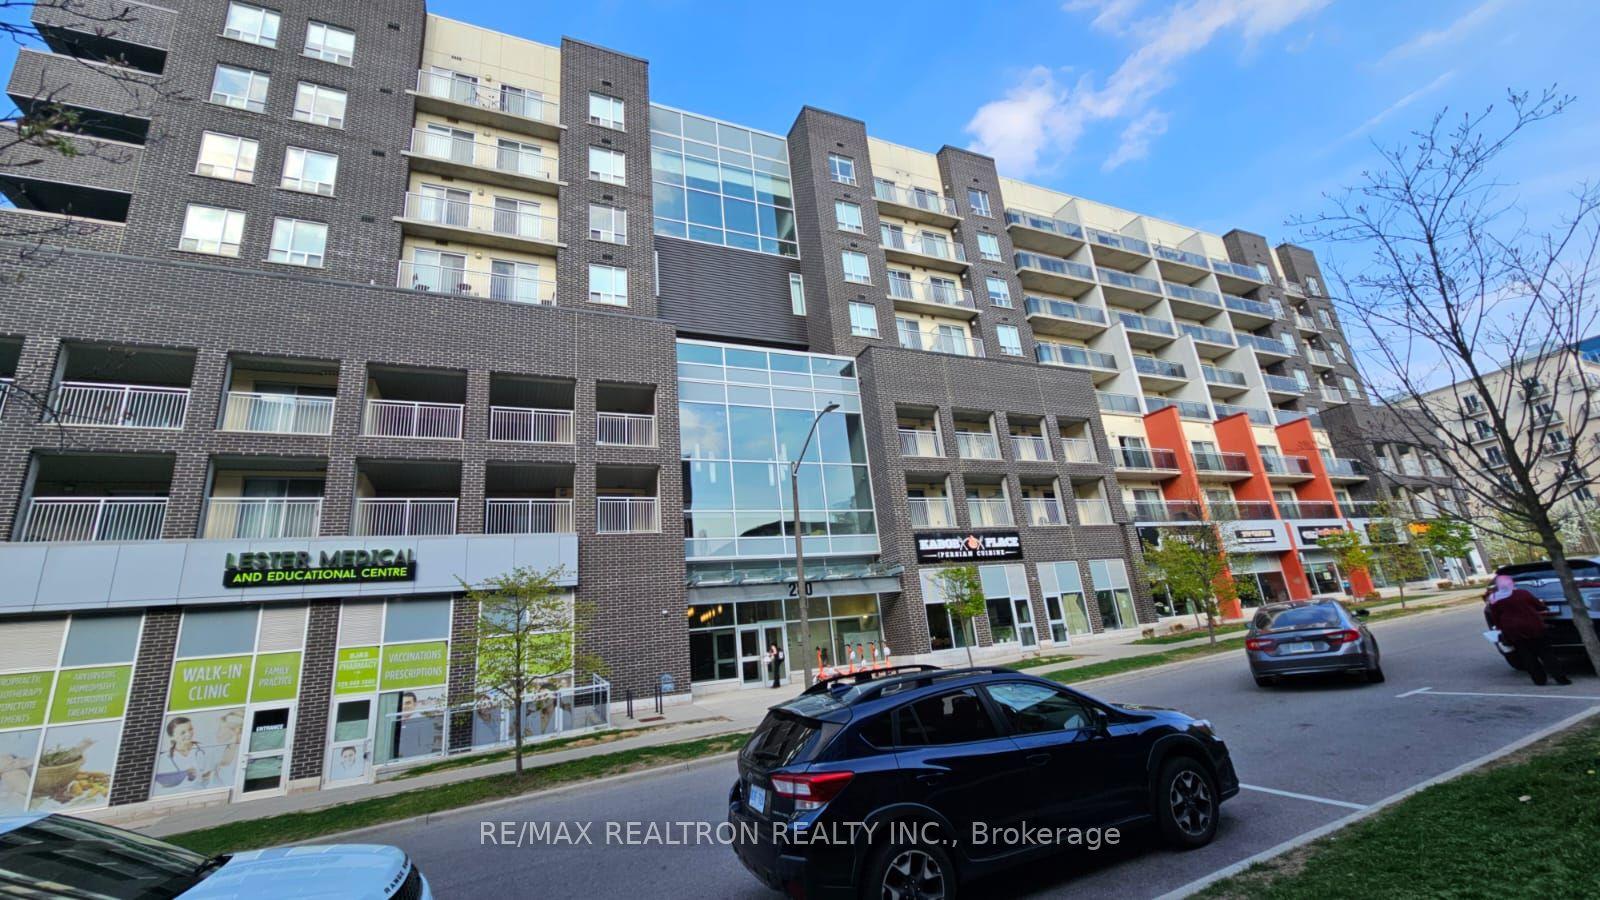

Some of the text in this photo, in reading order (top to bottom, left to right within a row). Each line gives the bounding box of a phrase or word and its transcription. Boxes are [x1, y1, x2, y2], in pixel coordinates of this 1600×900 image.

[985, 537, 1019, 548] PLACE
[225, 548, 417, 569] LESTER MEDICAL
[233, 567, 408, 583] AND EDUCATIONAL CENTRE
[788, 582, 813, 597] 20
[389, 650, 442, 663] VACCINATIONS
[183, 663, 243, 682] WALK-IN
[264, 666, 290, 676] FAMILY
[385, 667, 443, 680] PRESCRIPTIONS
[259, 676, 293, 688] PRACTICE
[188, 683, 231, 701] CLINIC
